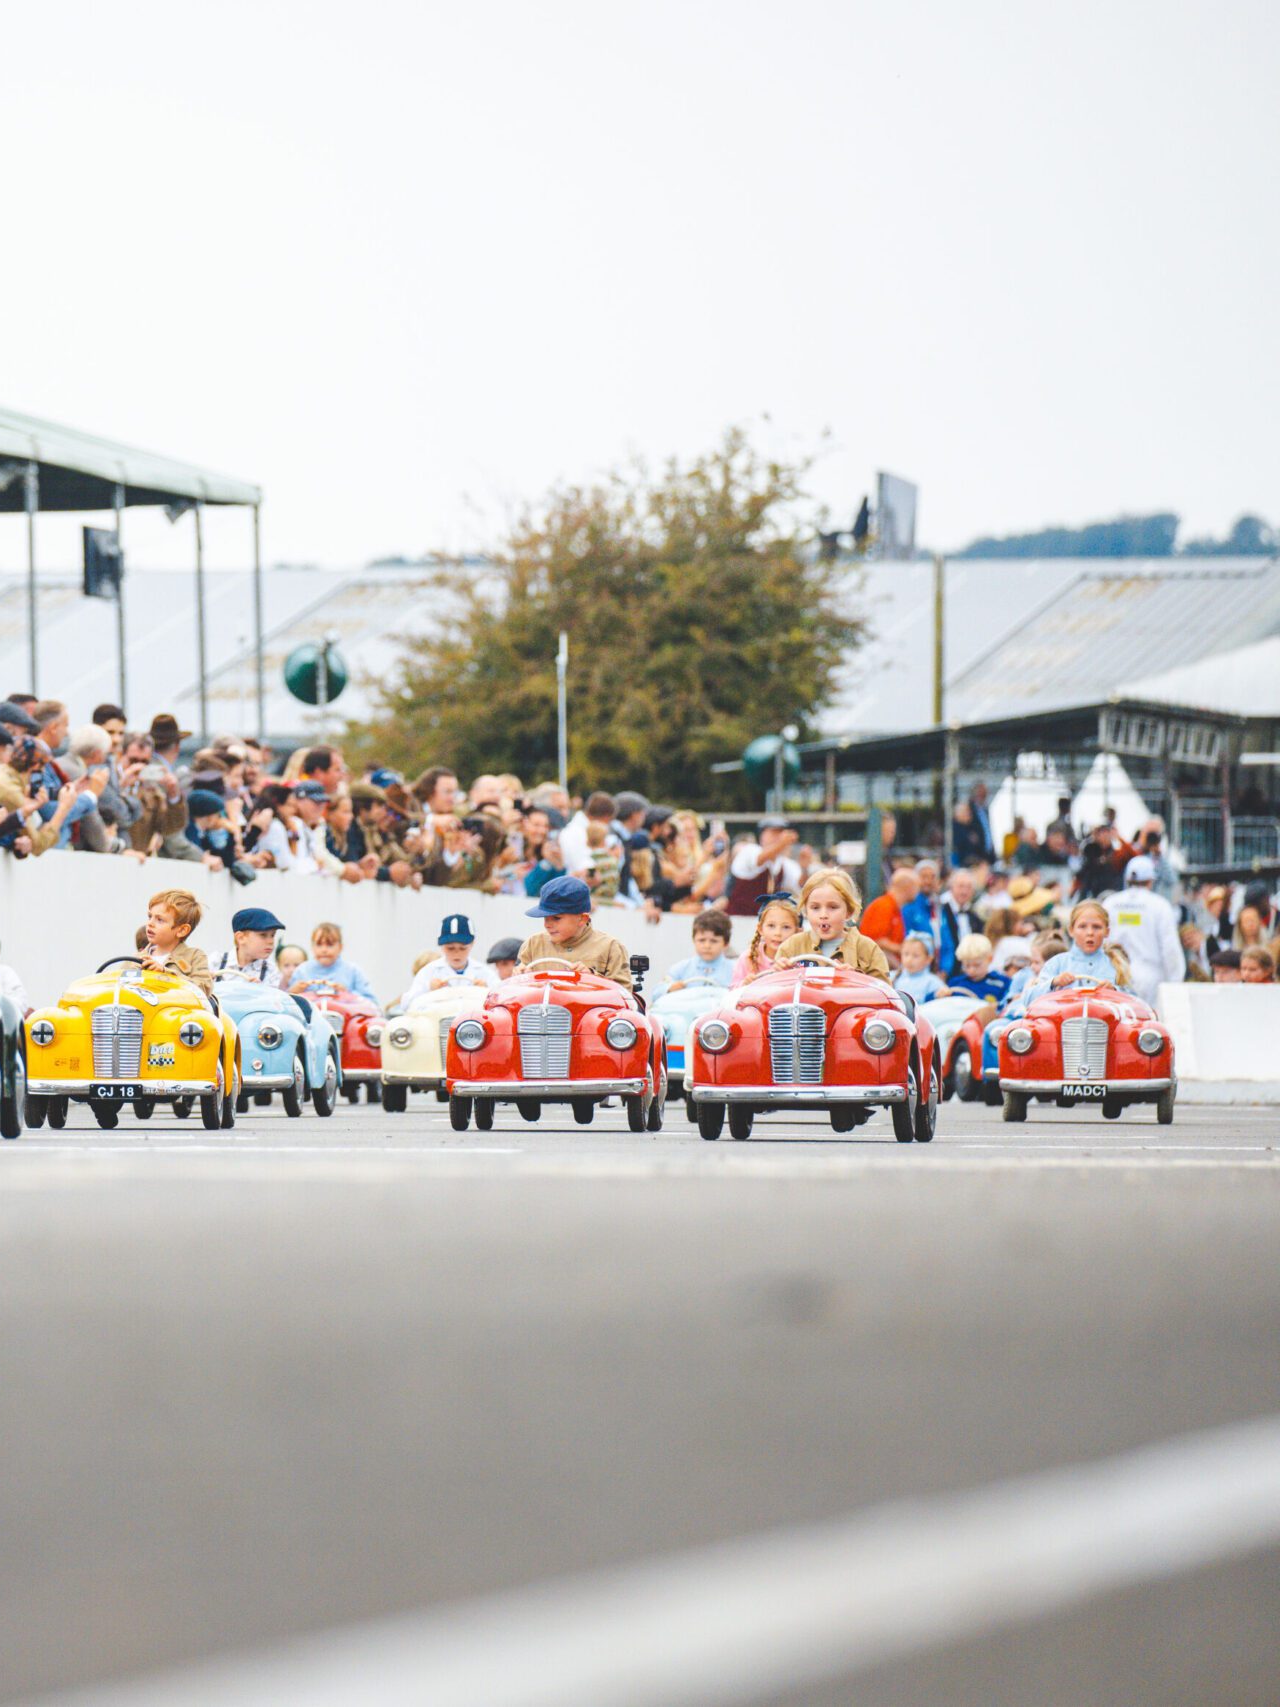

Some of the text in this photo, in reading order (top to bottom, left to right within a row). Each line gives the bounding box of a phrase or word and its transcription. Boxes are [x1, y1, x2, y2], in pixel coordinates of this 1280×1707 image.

[97, 1086, 135, 1098] CJ 18
[1062, 1085, 1107, 1097] MADC1
